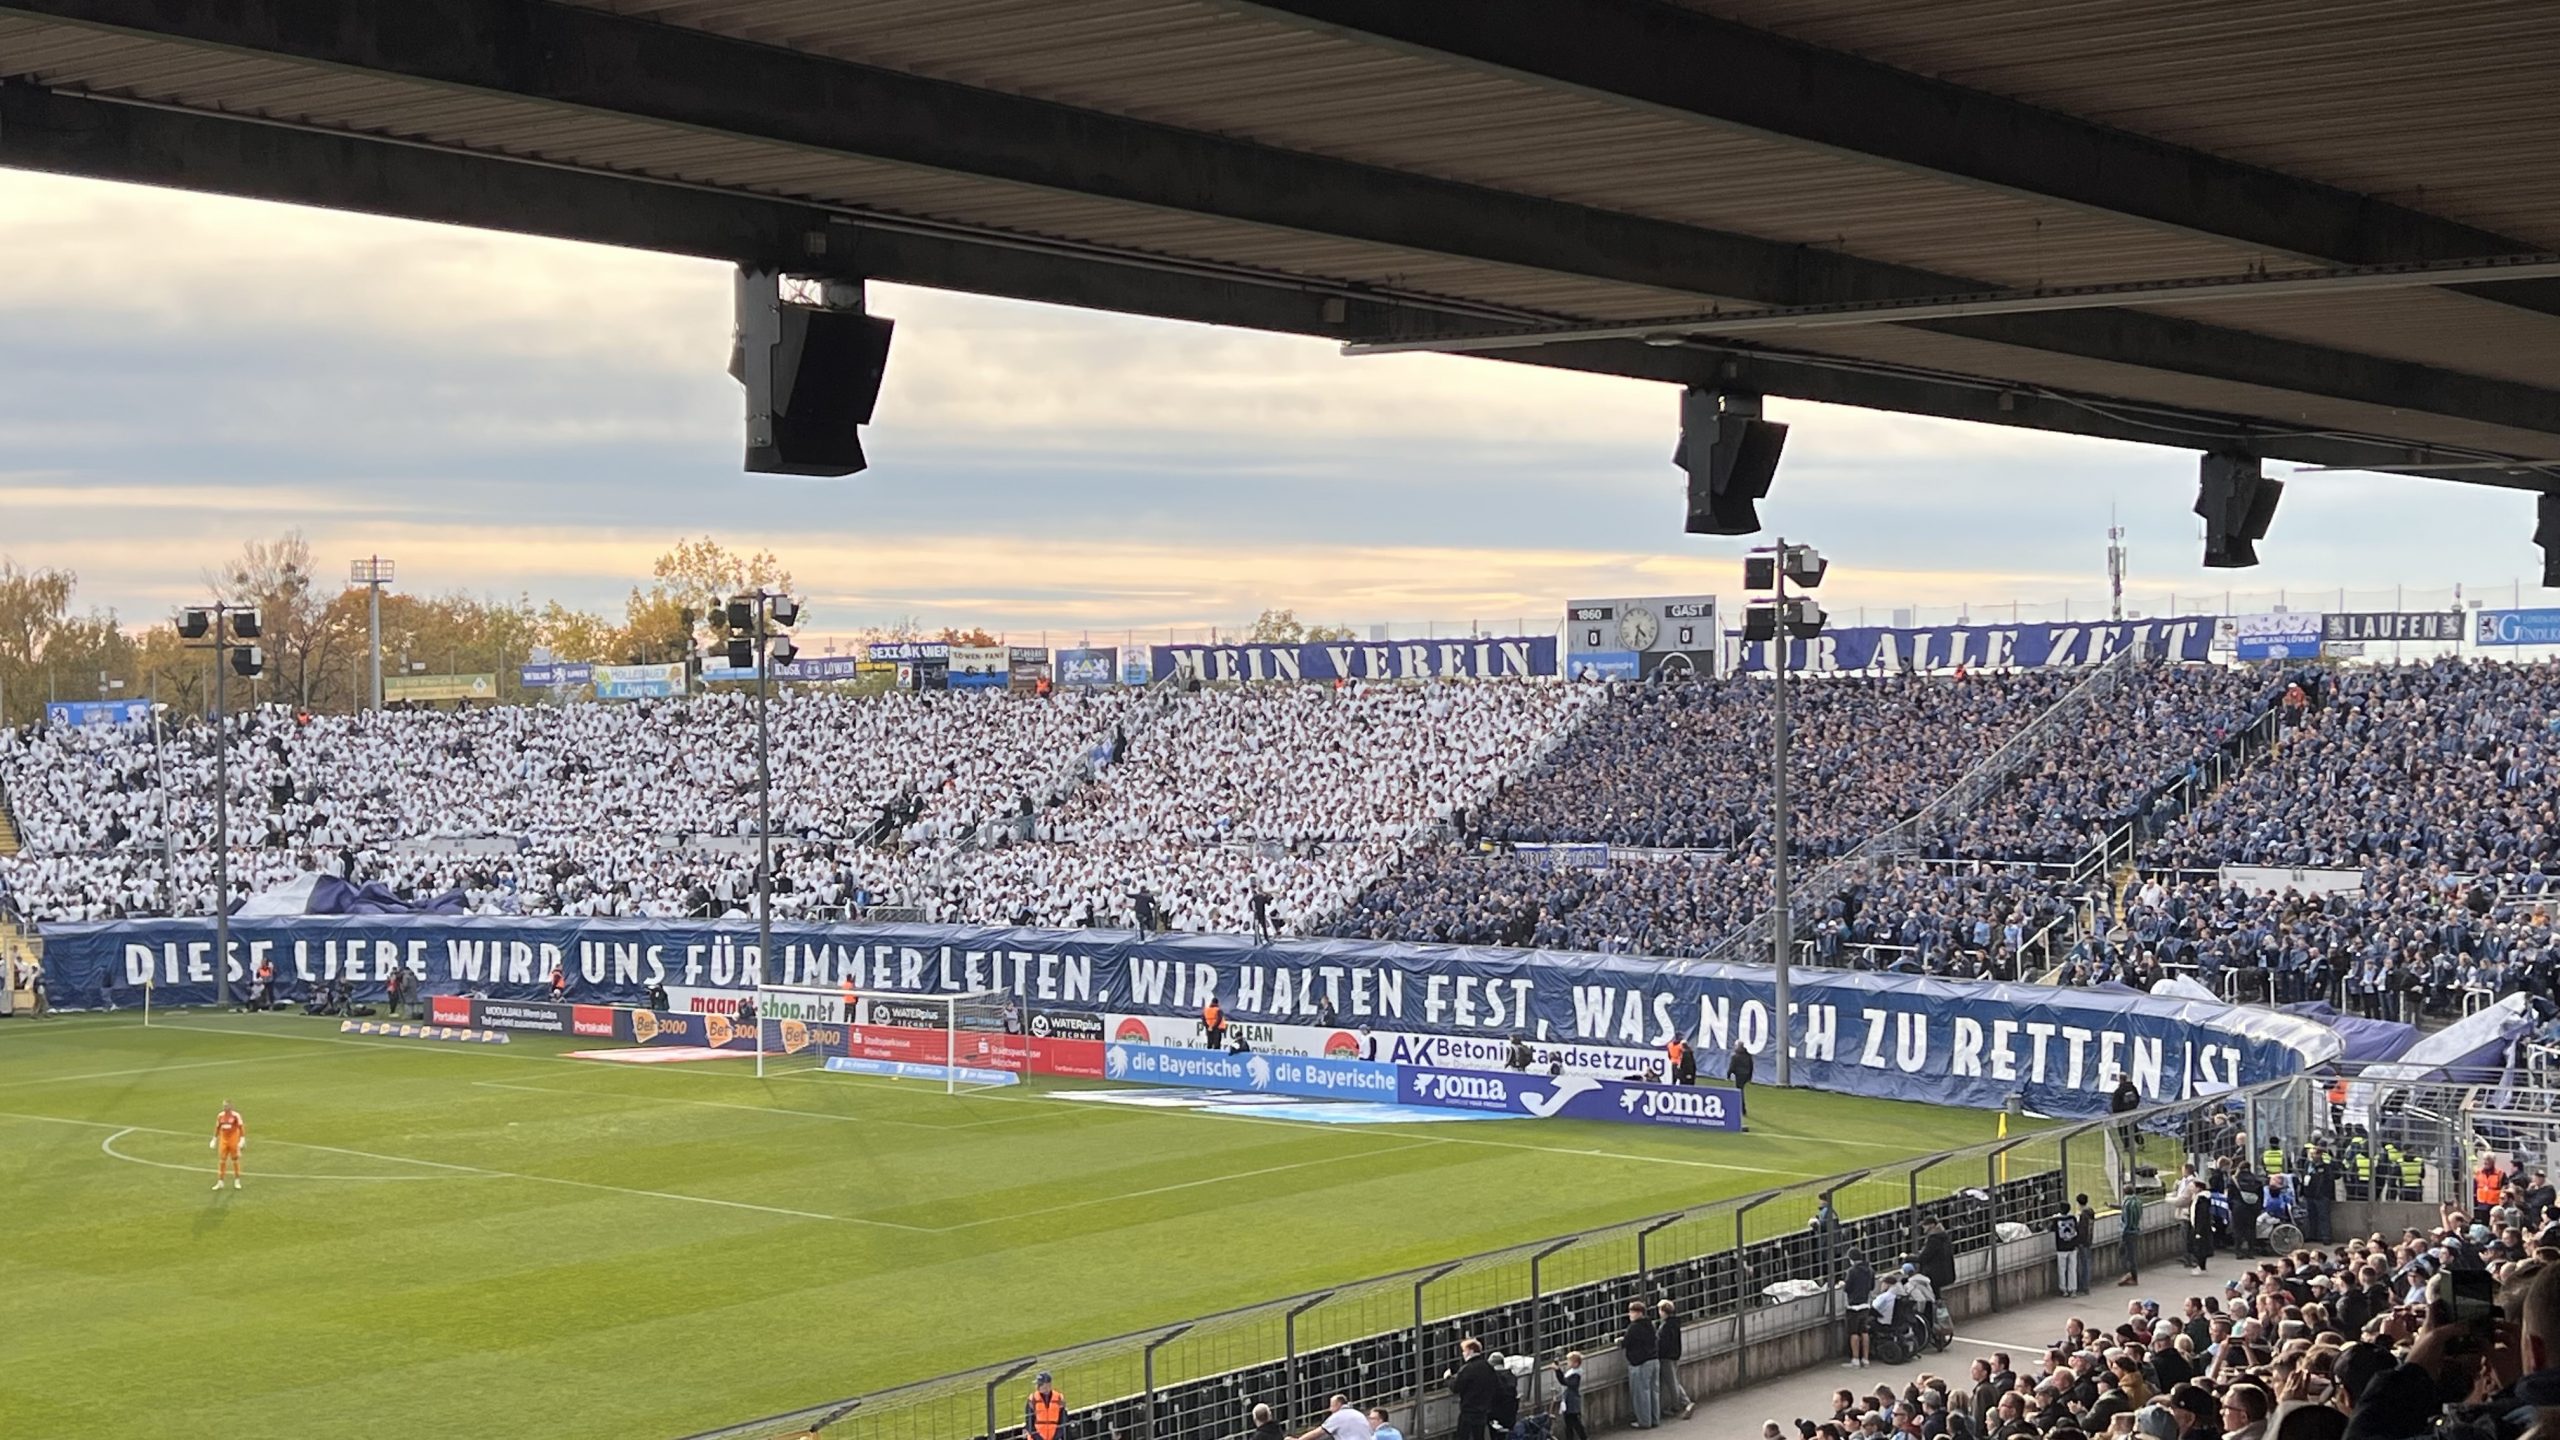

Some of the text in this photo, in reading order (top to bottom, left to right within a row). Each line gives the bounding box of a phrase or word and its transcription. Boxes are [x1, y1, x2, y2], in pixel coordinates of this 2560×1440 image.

[1577, 609, 1602, 620] 1860
[1671, 604, 1705, 616] GAST
[1682, 629, 1690, 642] 0
[2350, 615, 2438, 638] LAUFEN
[1590, 632, 1598, 645] 0
[1865, 630, 2019, 671] ALLE
[2045, 622, 2198, 666] ZEIT
[1170, 648, 1301, 682] MEIN
[1326, 642, 1531, 680] VEREIN
[617, 682, 659, 696] LÖWEN
[126, 939, 273, 985] DIESE
[295, 939, 427, 982] LIEBE
[447, 939, 562, 983] WIRD
[580, 939, 665, 985] UNS
[685, 935, 762, 986] FÜR
[783, 943, 923, 990] IMMER
[1129, 956, 1219, 1007] WIR
[1236, 965, 1402, 1019] HALTEN
[1572, 984, 1675, 1047] WAS
[1859, 1007, 1928, 1074] ZU
[1952, 1016, 2163, 1099] RETTEN
[2181, 1040, 2241, 1100] IST
[1050, 1017, 1102, 1032] WATERplus
[1390, 1035, 1436, 1067] AK
[1132, 1054, 1242, 1079] die Bayerische
[1275, 1064, 1397, 1091] die Bayerische
